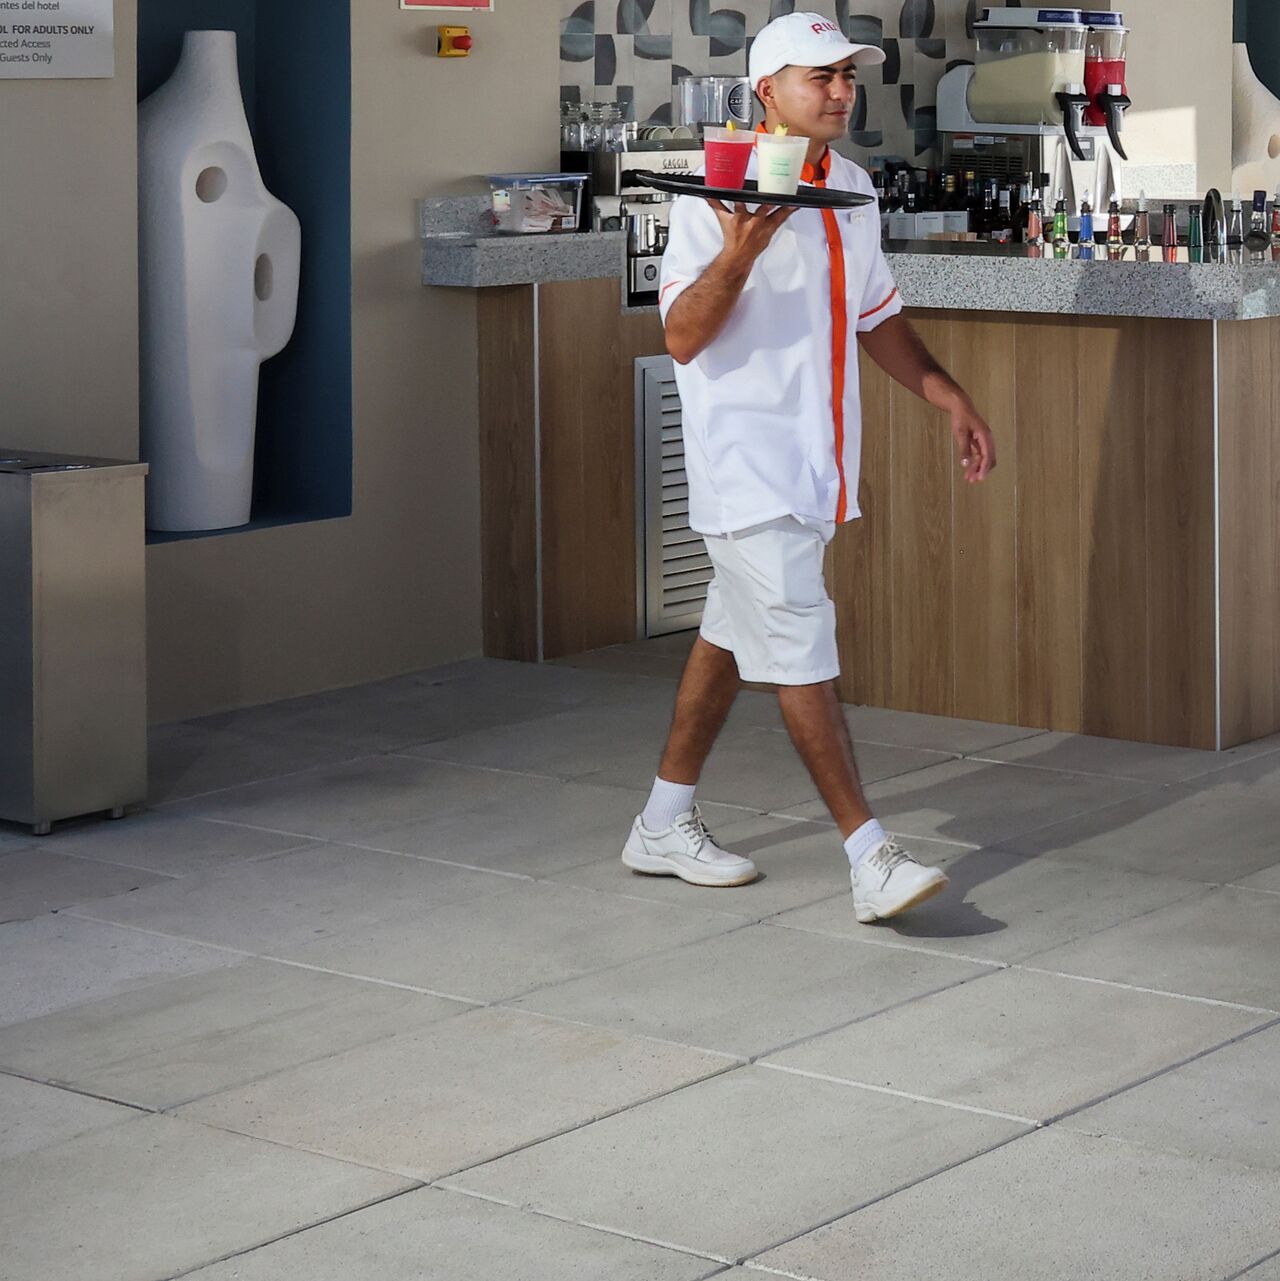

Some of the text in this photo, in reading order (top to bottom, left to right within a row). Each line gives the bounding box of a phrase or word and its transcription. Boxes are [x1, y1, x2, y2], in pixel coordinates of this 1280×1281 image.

[21, 1, 36, 10] del
[37, 2, 60, 11] hotel
[12, 24, 31, 34] FOR
[33, 25, 69, 35] ADULTS
[70, 25, 95, 35] ONLY
[20, 39, 52, 49] Access
[31, 52, 53, 64] Only
[662, 158, 688, 169] GAGGIA
